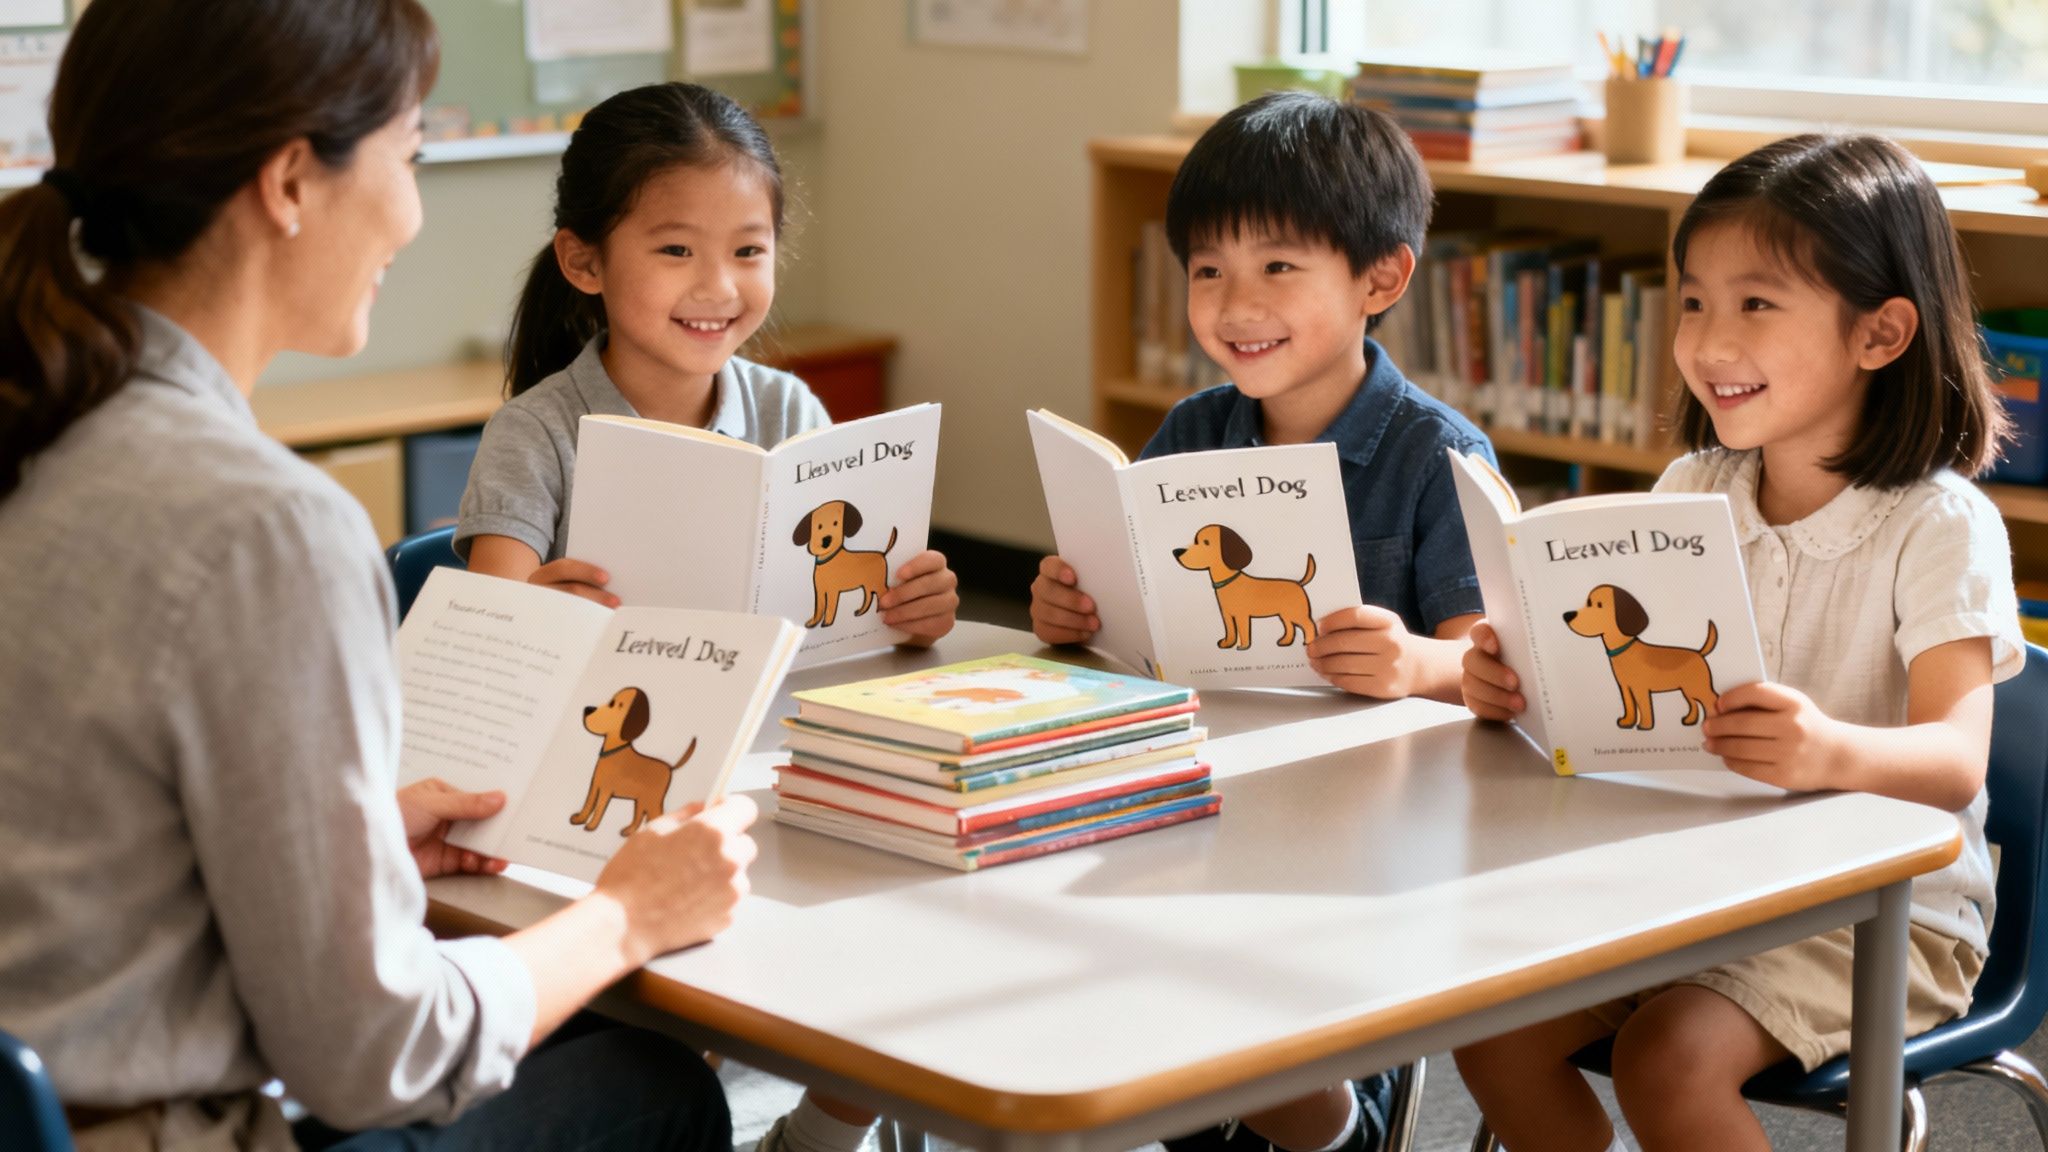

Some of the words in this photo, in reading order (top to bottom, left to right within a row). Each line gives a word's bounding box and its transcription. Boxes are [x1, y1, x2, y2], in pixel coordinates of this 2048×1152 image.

[872, 440, 915, 461] Dog
[1256, 476, 1308, 500] Dog
[1650, 530, 1705, 557] Dog
[695, 640, 740, 672] Dog
